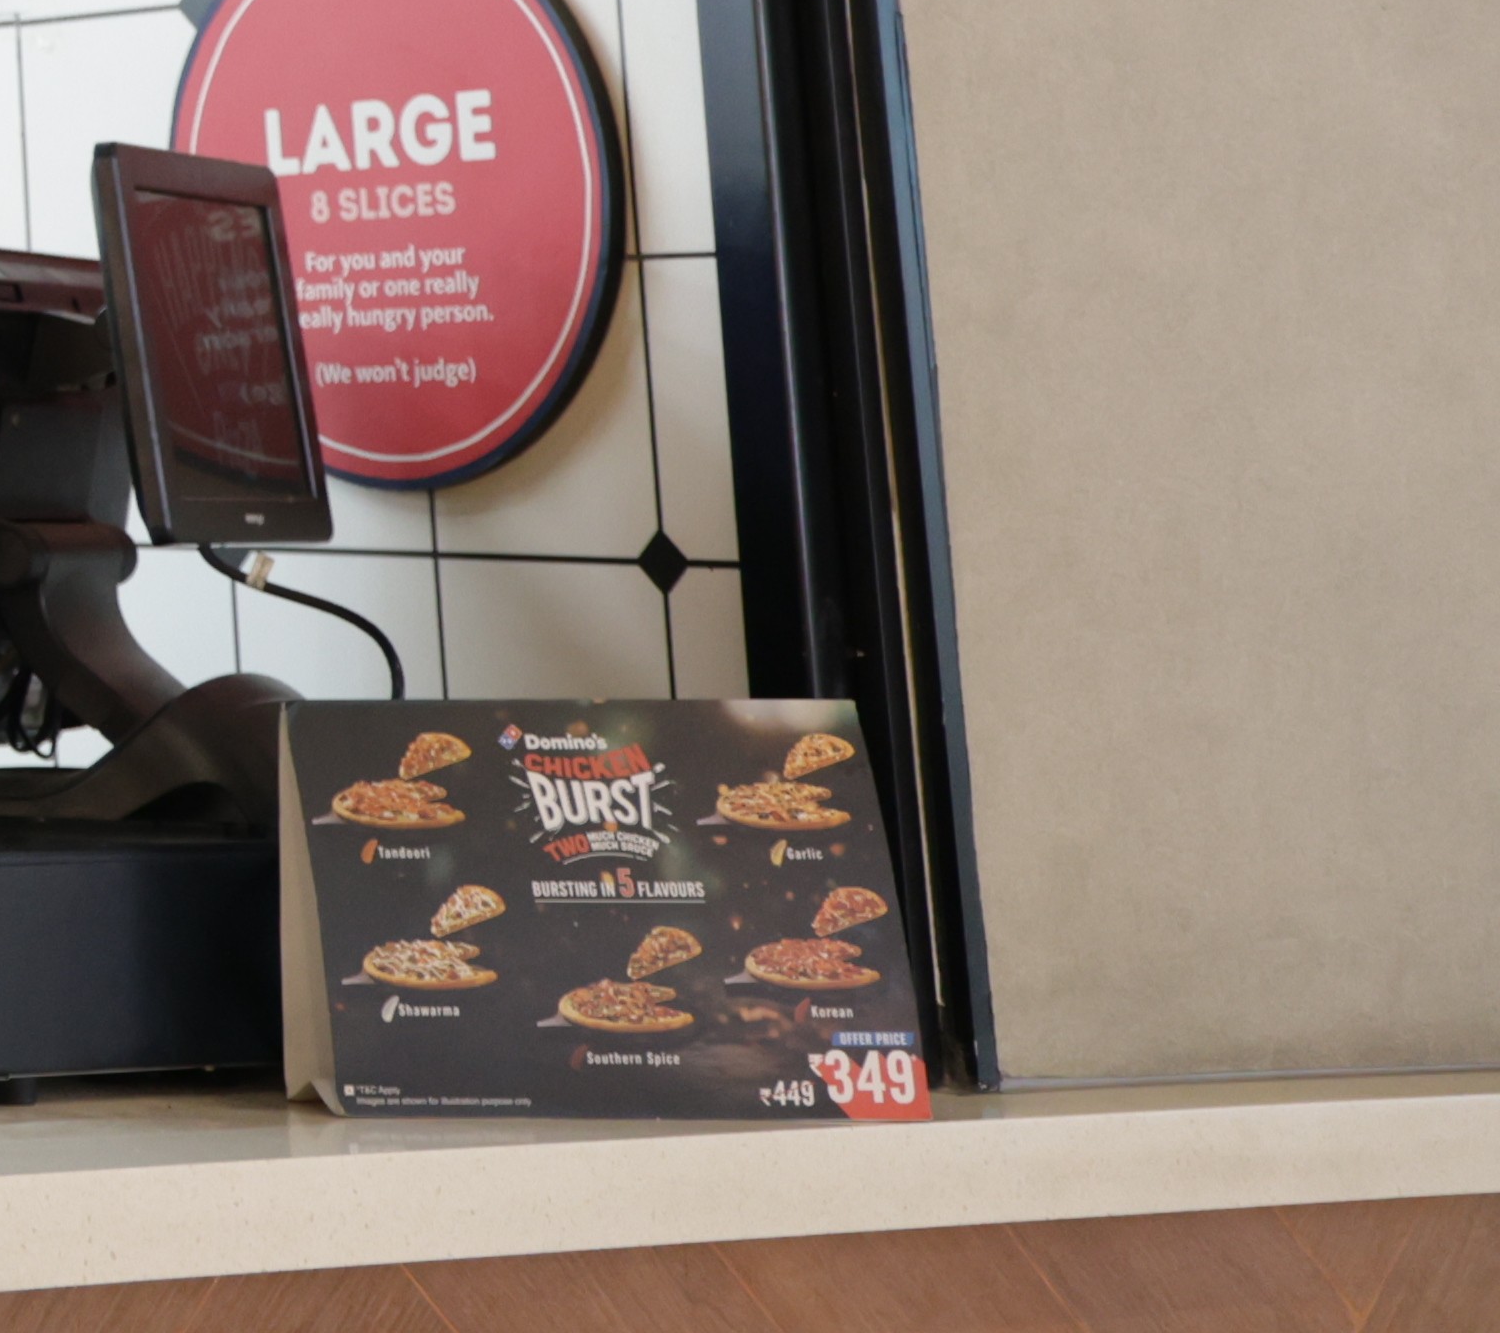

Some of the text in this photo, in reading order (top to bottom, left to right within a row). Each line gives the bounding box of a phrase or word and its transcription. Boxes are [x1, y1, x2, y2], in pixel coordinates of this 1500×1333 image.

[264, 89, 497, 177] LARGE
[311, 183, 456, 223] 8 SLICES
[304, 243, 466, 278] For you and your
[296, 269, 480, 306] family or one really
[299, 304, 495, 334] eally hungry person.
[315, 356, 477, 388] (We won't judge)
[524, 733, 608, 751] Domino's
[524, 743, 652, 780] CHICKEN
[526, 771, 655, 831] BURST
[378, 844, 431, 860] Tandoori
[542, 833, 591, 861] TWO
[786, 846, 823, 861] Garlic
[532, 868, 705, 898] BURSTING IN 5 FLAVOURS
[398, 1002, 460, 1017] Shawarma
[811, 1004, 854, 1019] Korean
[840, 1032, 908, 1046] OFFER PRICE
[586, 1050, 680, 1067] Southern Spice
